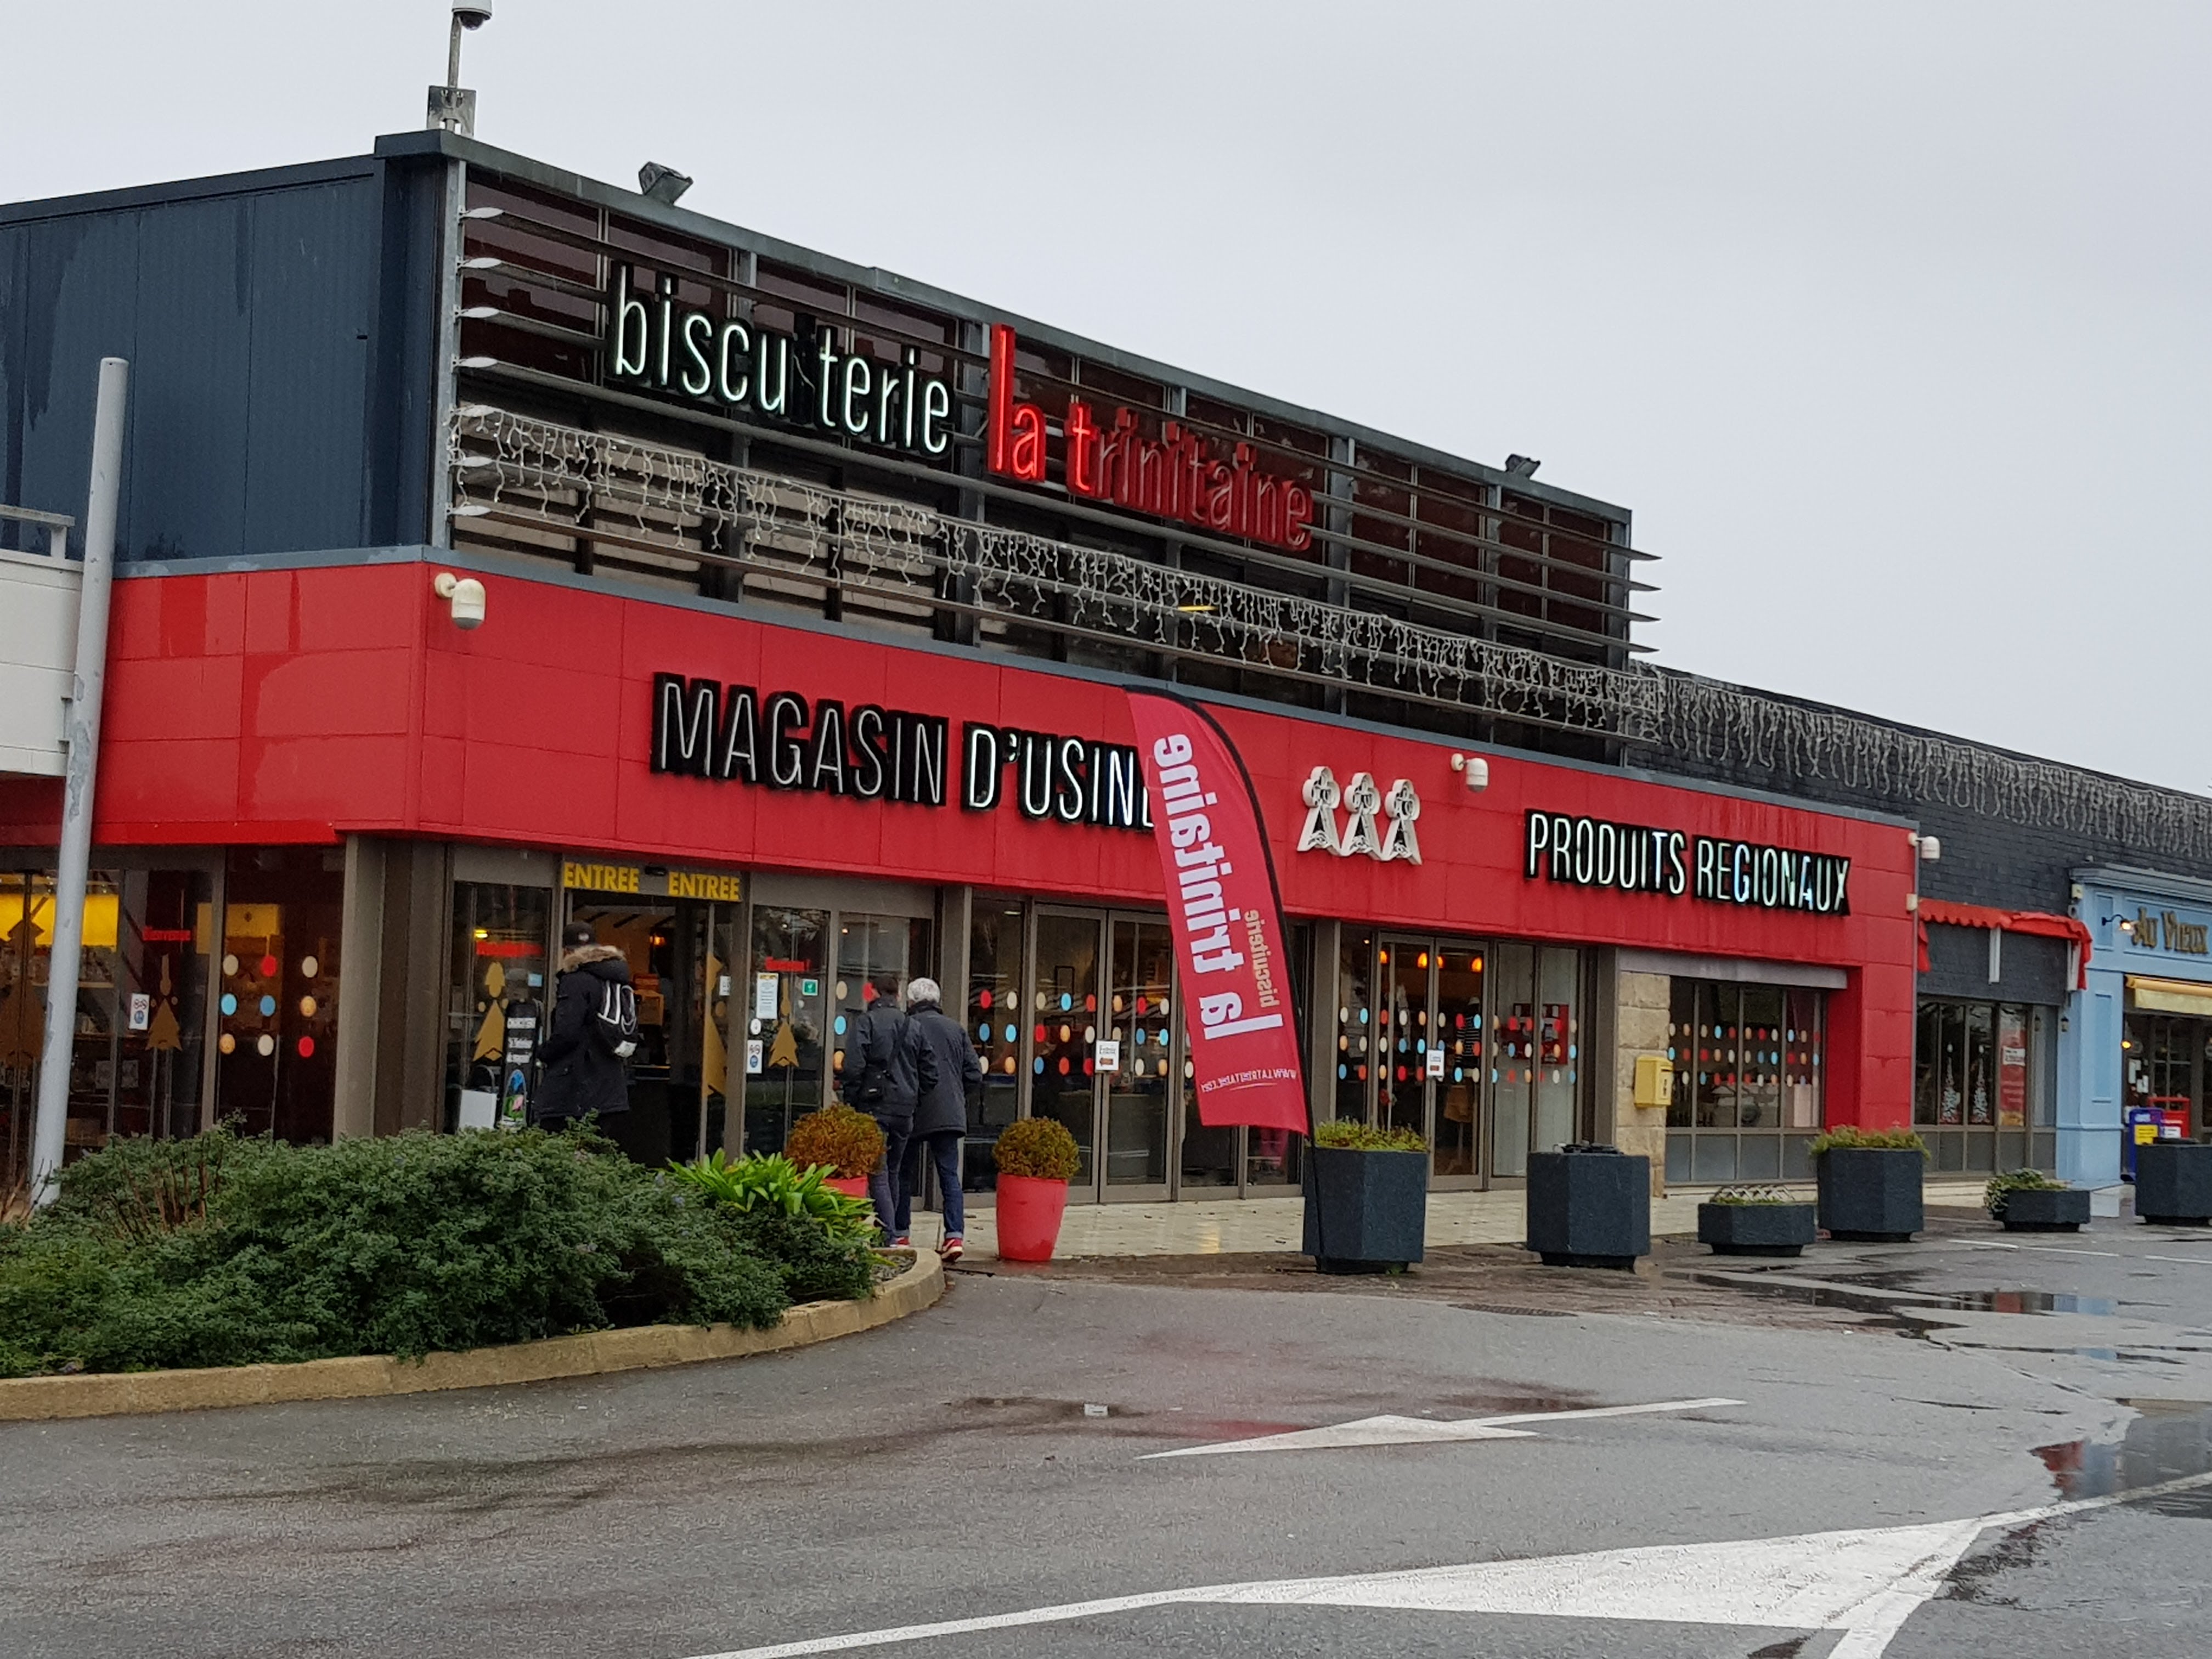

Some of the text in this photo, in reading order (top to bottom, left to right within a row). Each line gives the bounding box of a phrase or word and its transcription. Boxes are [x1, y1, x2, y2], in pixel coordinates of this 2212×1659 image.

[989, 324, 1045, 481] la
[1066, 403, 1312, 549] trinitaine
[654, 676, 947, 806] MAGASIN
[563, 861, 740, 901] ENTREE ENTREE
[1527, 811, 1849, 914] PRODUITS REGIONAUX
